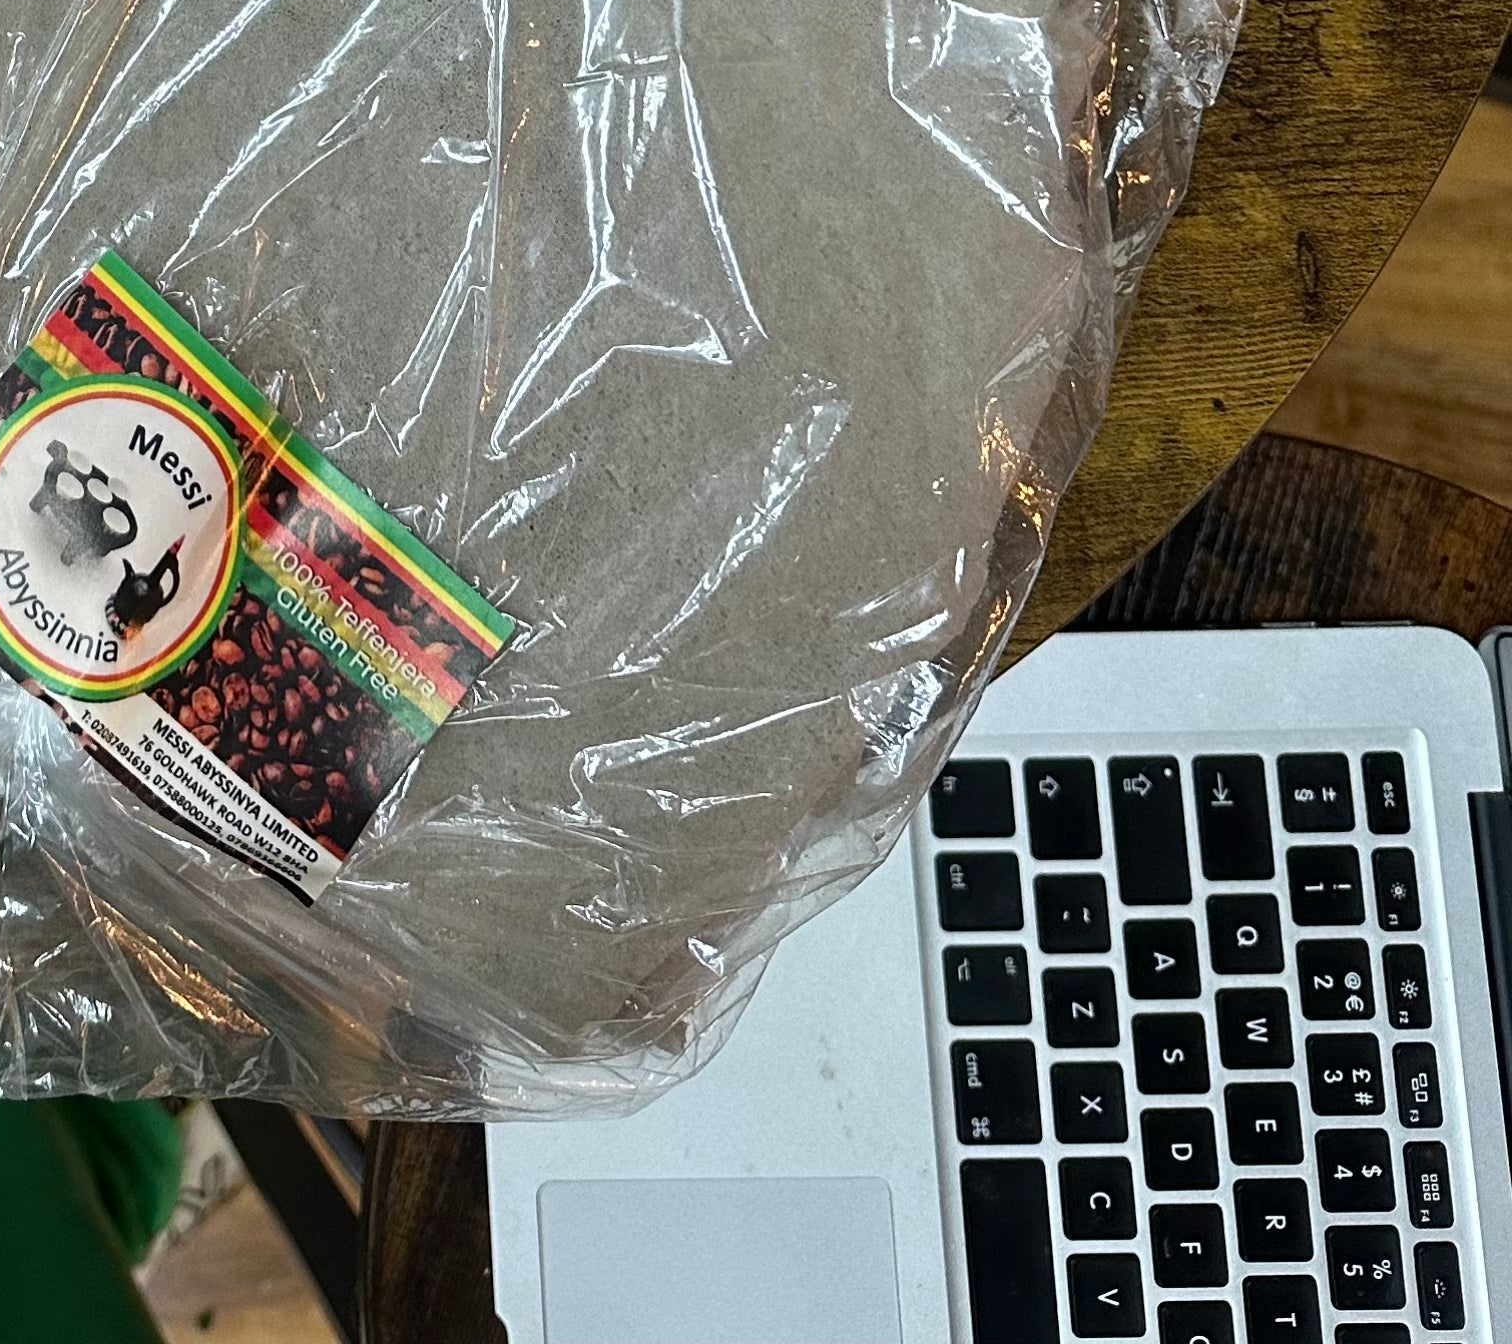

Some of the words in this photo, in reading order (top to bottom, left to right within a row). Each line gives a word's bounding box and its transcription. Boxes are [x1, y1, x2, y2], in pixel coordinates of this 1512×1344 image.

[127, 422, 214, 513] Messi
[272, 543, 332, 605] 100%
[333, 595, 437, 698] Teffenjera
[276, 586, 350, 658] Gluten
[348, 650, 398, 701] Free
[138, 733, 153, 754] 76
[152, 748, 220, 811] GOLDHAWK
[217, 804, 253, 838] ROAD
[253, 831, 283, 858] W12
[152, 717, 195, 758] MESSI
[190, 754, 263, 821] ABYSSINYA
[261, 814, 320, 864] LIMITED
[1382, 781, 1396, 808] esc
[1304, 882, 1324, 891] 1
[1388, 913, 1399, 925] F1
[1236, 925, 1259, 947] Q
[1153, 952, 1176, 971] A
[1313, 975, 1334, 990] 2
[1071, 1001, 1094, 1019] Z
[1398, 1010, 1409, 1024] F2
[1246, 1017, 1269, 1043] W
[1162, 1048, 1184, 1064] S
[965, 1052, 983, 1088] cmd
[1323, 1069, 1344, 1084] 3
[1352, 1068, 1372, 1084] £
[1080, 1095, 1103, 1115] X
[1409, 1109, 1420, 1123] F3
[1255, 1119, 1277, 1133] E
[1170, 1143, 1193, 1161] D
[1333, 1164, 1354, 1180] 4
[1361, 1165, 1383, 1178] $
[1089, 1191, 1111, 1210] C
[1264, 1215, 1287, 1230] R
[1419, 1209, 1431, 1223] F4
[1179, 1242, 1202, 1255] F
[1343, 1263, 1364, 1277] 5
[1372, 1259, 1393, 1280] %
[1097, 1288, 1120, 1306] V
[1274, 1312, 1297, 1328] T
[1430, 1311, 1441, 1325] F5
